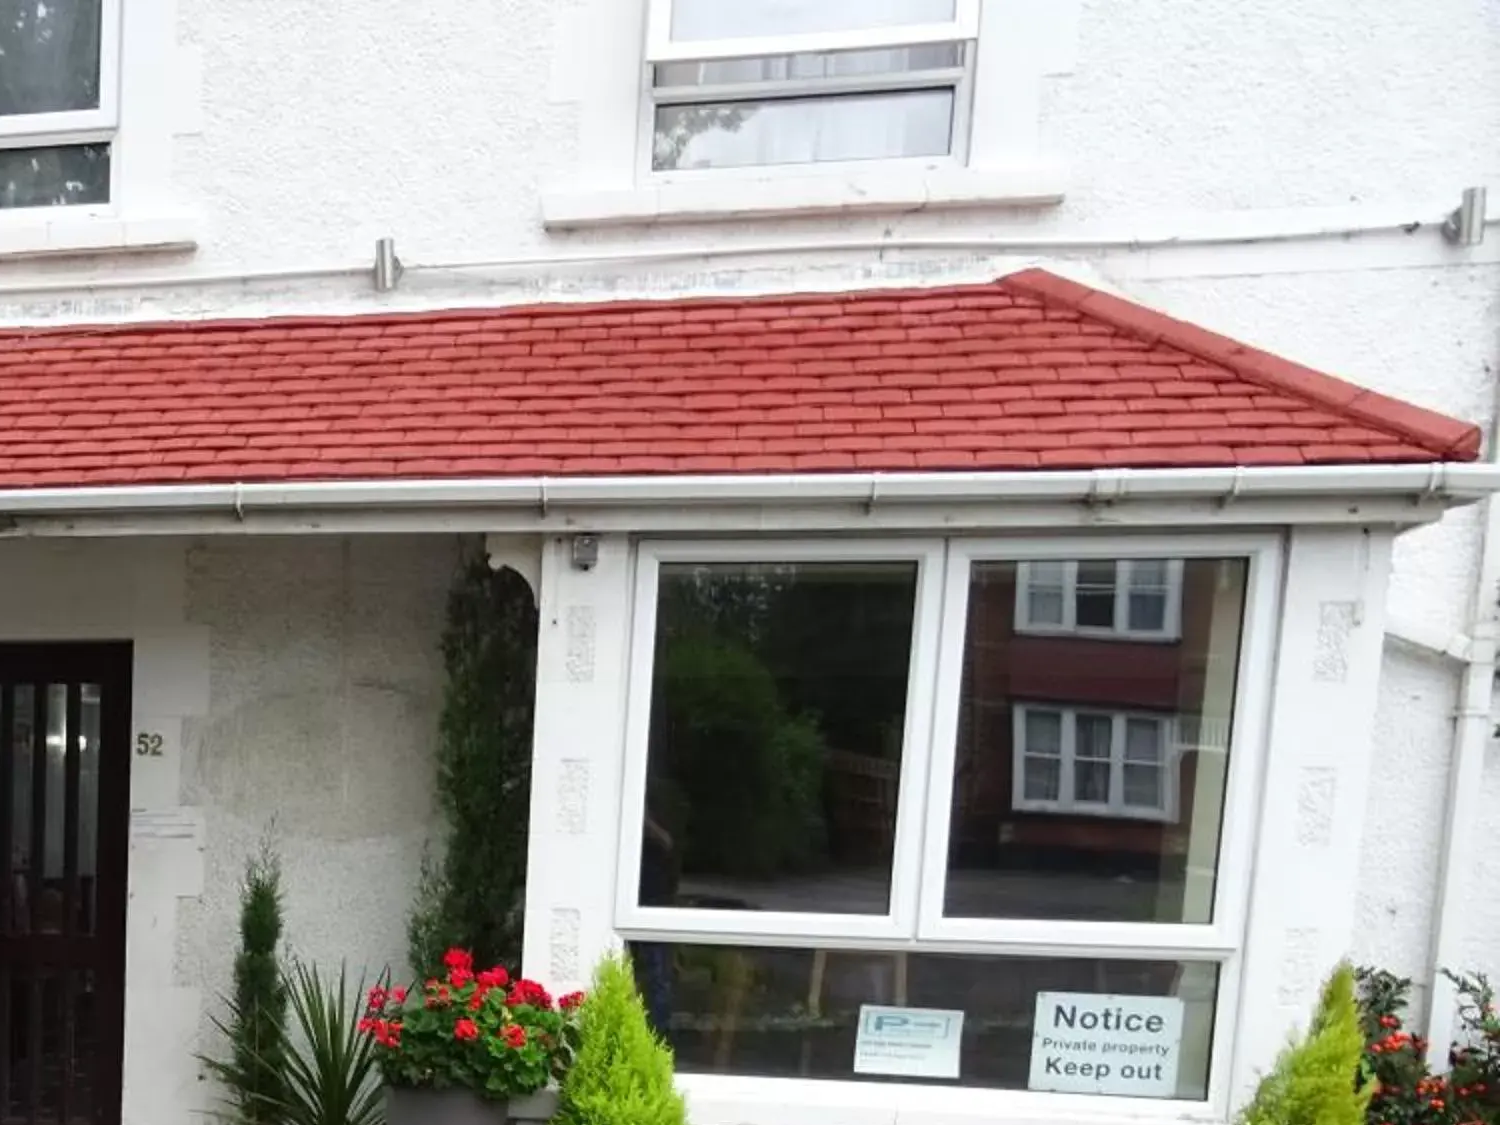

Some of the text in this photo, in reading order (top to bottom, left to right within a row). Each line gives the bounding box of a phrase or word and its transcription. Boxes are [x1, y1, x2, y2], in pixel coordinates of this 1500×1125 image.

[136, 732, 163, 756] 52
[1053, 1004, 1164, 1033] Notice
[1042, 1037, 1169, 1057] Private property
[1045, 1056, 1162, 1081] Keep out
